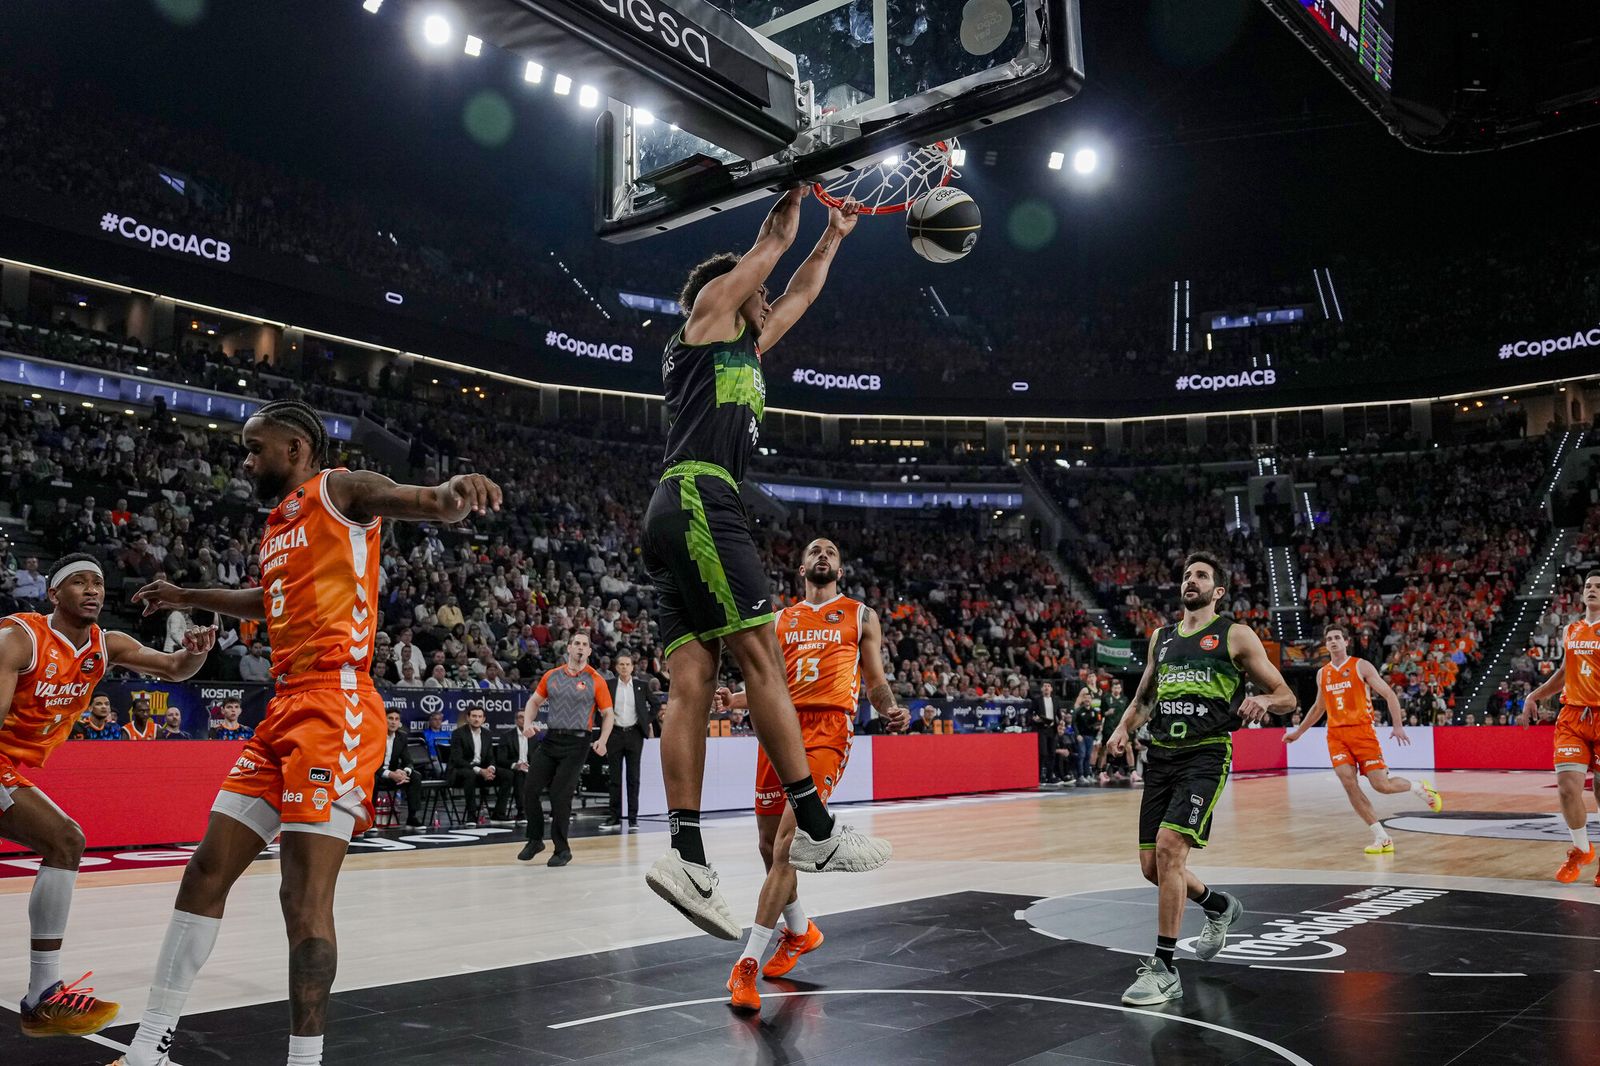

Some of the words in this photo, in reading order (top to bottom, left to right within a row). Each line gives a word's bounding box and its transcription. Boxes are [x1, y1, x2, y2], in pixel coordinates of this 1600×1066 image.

[101, 212, 231, 262] #CopaACB
[546, 331, 634, 363] #CopaACB
[793, 369, 881, 391] #CopaACB
[1176, 369, 1276, 391] #CopaACB
[785, 630, 842, 644] VALENCIA
[798, 643, 826, 651] BASKET
[795, 658, 820, 682] 13
[1580, 660, 1592, 677] 4
[456, 696, 512, 713] endesa
[1159, 701, 1195, 715] sisa
[1336, 696, 1344, 710] 3
[311, 773, 326, 781] acb
[755, 791, 781, 799] PULEVA
[1222, 889, 1450, 956] mediolanum
